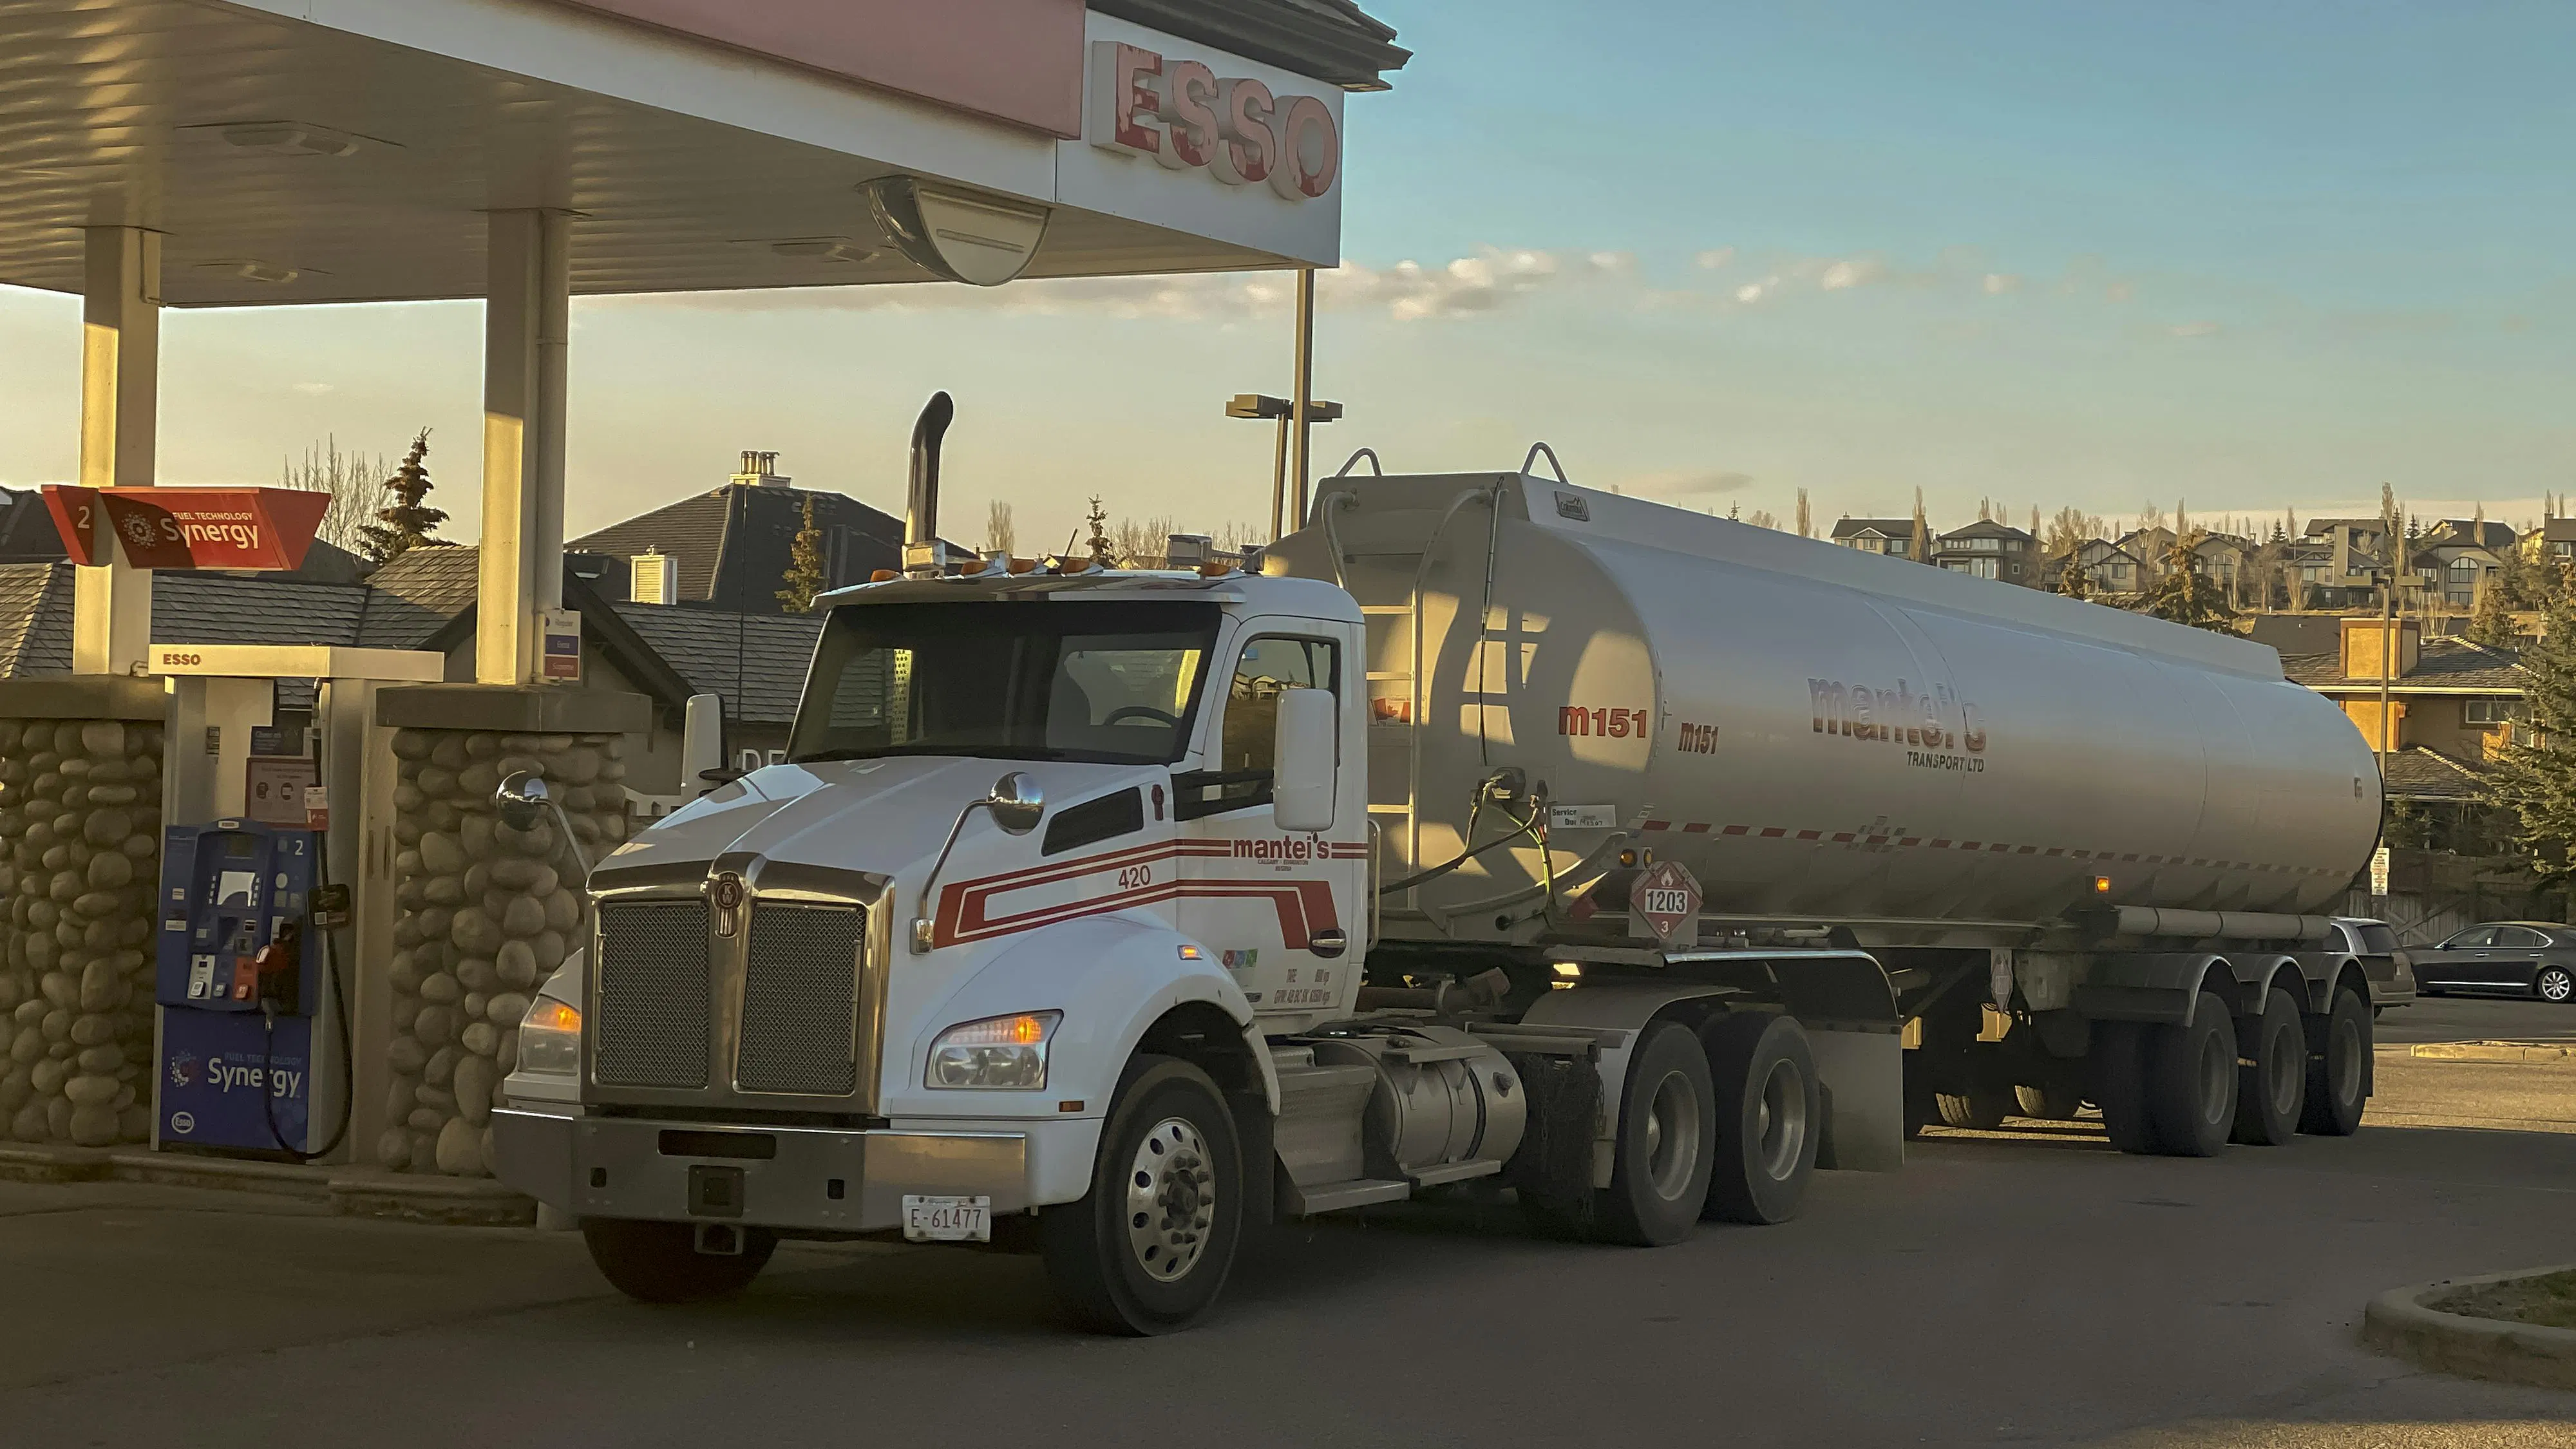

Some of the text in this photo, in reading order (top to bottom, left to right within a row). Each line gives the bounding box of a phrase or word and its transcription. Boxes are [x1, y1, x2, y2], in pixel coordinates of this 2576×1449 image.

[1093, 41, 1338, 200] ESSO
[77, 506, 90, 529] 2
[172, 512, 252, 520] FUEL TECHNOLOGY
[161, 518, 258, 549] Synergy
[163, 654, 201, 665] ESSO
[1558, 706, 1647, 739] m151
[1678, 722, 1719, 755] m151
[1907, 751, 1985, 773] TRANSPORT LTD
[294, 839, 303, 856] 2
[1234, 833, 1329, 859] mantei's
[1119, 865, 1151, 889] 420
[1647, 890, 1685, 913] 1203
[1661, 921, 1669, 933] 3
[207, 1057, 301, 1098] Synegy
[911, 1209, 981, 1229] E-61477
